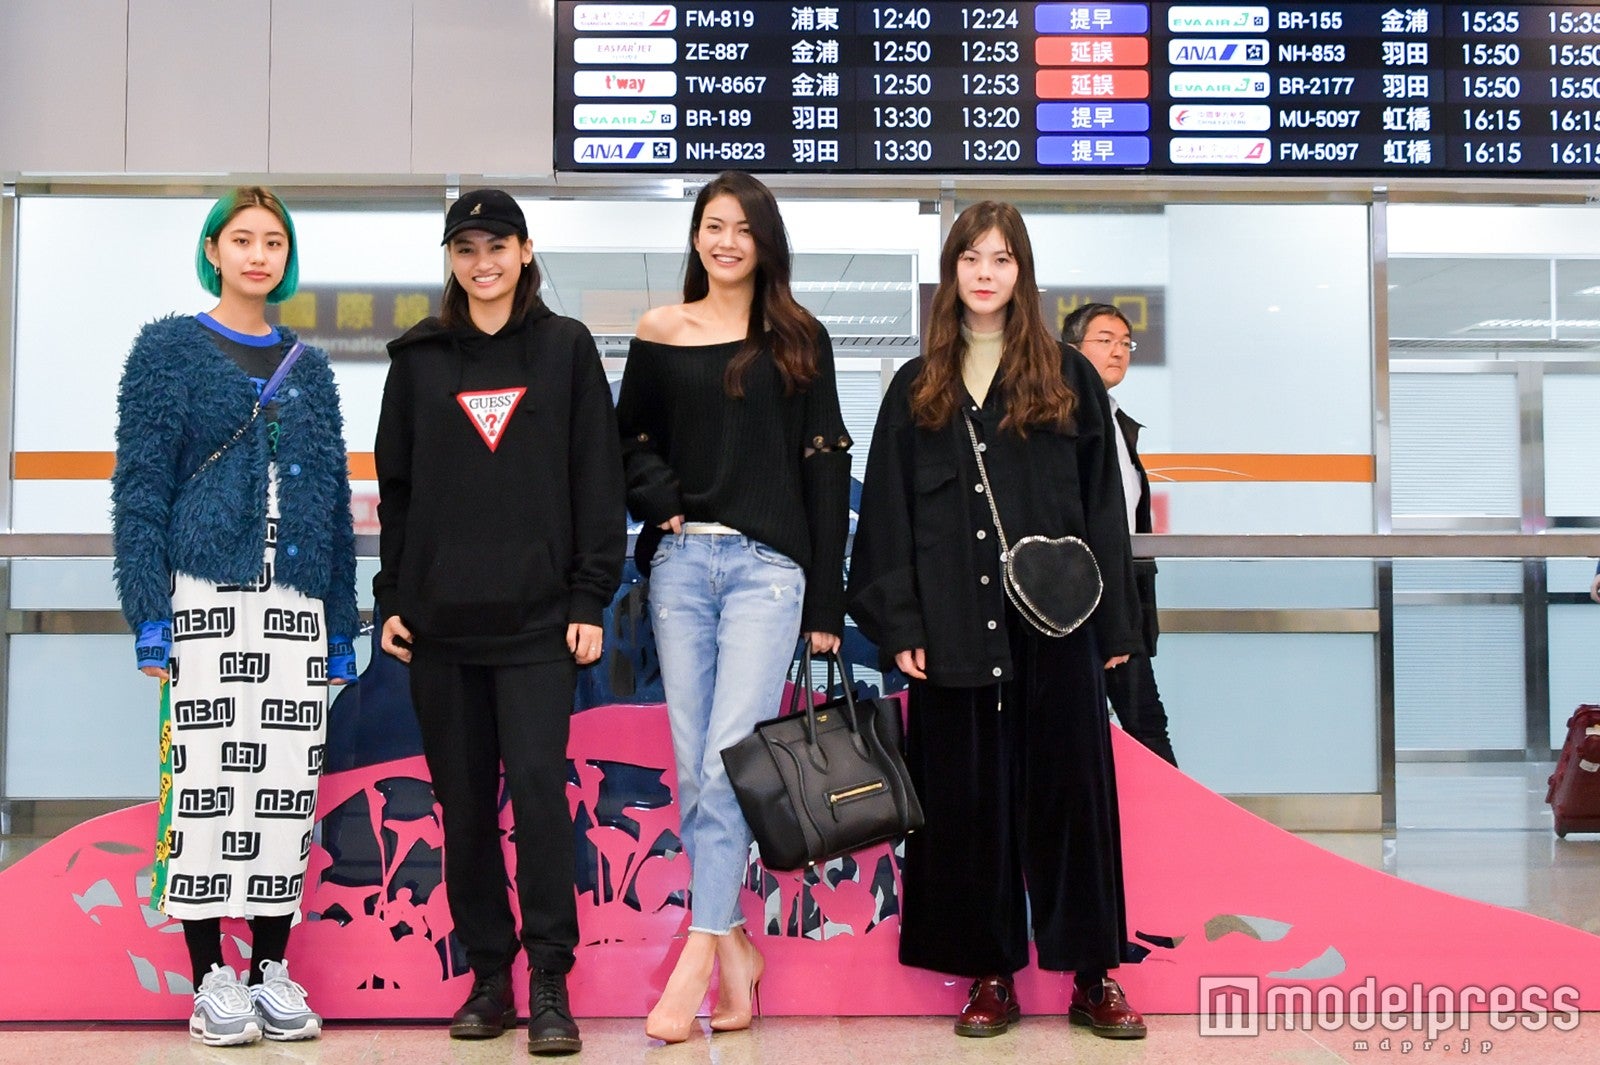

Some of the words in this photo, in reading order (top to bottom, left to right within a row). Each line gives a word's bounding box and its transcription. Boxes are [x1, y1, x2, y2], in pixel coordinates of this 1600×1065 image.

[687, 11, 754, 28] FM-819
[791, 7, 840, 31] 浦東
[873, 8, 931, 30] 12:40
[961, 9, 1019, 29] 12:24
[1070, 8, 1113, 30] 提早
[1278, 12, 1343, 29] BR-155
[1381, 8, 1429, 33] 金浦
[1462, 11, 1520, 33] 15:35
[685, 43, 749, 61] ZE-887
[791, 40, 840, 64] 金浦
[873, 41, 931, 62] 12:50
[961, 41, 1019, 62] 12:53
[1070, 41, 1114, 63] 延誤
[1175, 46, 1217, 61] ANA
[1278, 44, 1346, 62] NH-853
[1381, 42, 1429, 66] 羽田
[1462, 44, 1520, 66] 15:50
[685, 76, 767, 94] TW-8667
[791, 73, 840, 97] 金浦
[873, 74, 932, 95] 12:50
[962, 74, 1020, 95] 12:53
[1071, 74, 1115, 96] 延誤
[1279, 77, 1355, 95] BR-2177
[1382, 75, 1429, 98] 羽田
[1463, 76, 1521, 98] 15:50
[686, 109, 752, 127] BR-189
[792, 106, 839, 130] 羽田
[873, 107, 932, 128] 13:30
[962, 107, 1020, 128] 13:20
[1071, 107, 1115, 129] 提早
[1279, 110, 1361, 128] MU-5097
[1382, 107, 1431, 131] 虹橋
[1463, 109, 1521, 131] 16:15
[581, 144, 623, 159] ANA
[686, 142, 766, 160] NH-5823
[792, 139, 839, 163] 羽田
[873, 140, 932, 161] 13:30
[962, 140, 1021, 161] 13:20
[1071, 140, 1115, 162] 提早
[1280, 143, 1359, 160] FM-5097
[1383, 140, 1431, 164] 虹橋
[1464, 142, 1522, 164] 16:15
[469, 395, 512, 410] GUESS
